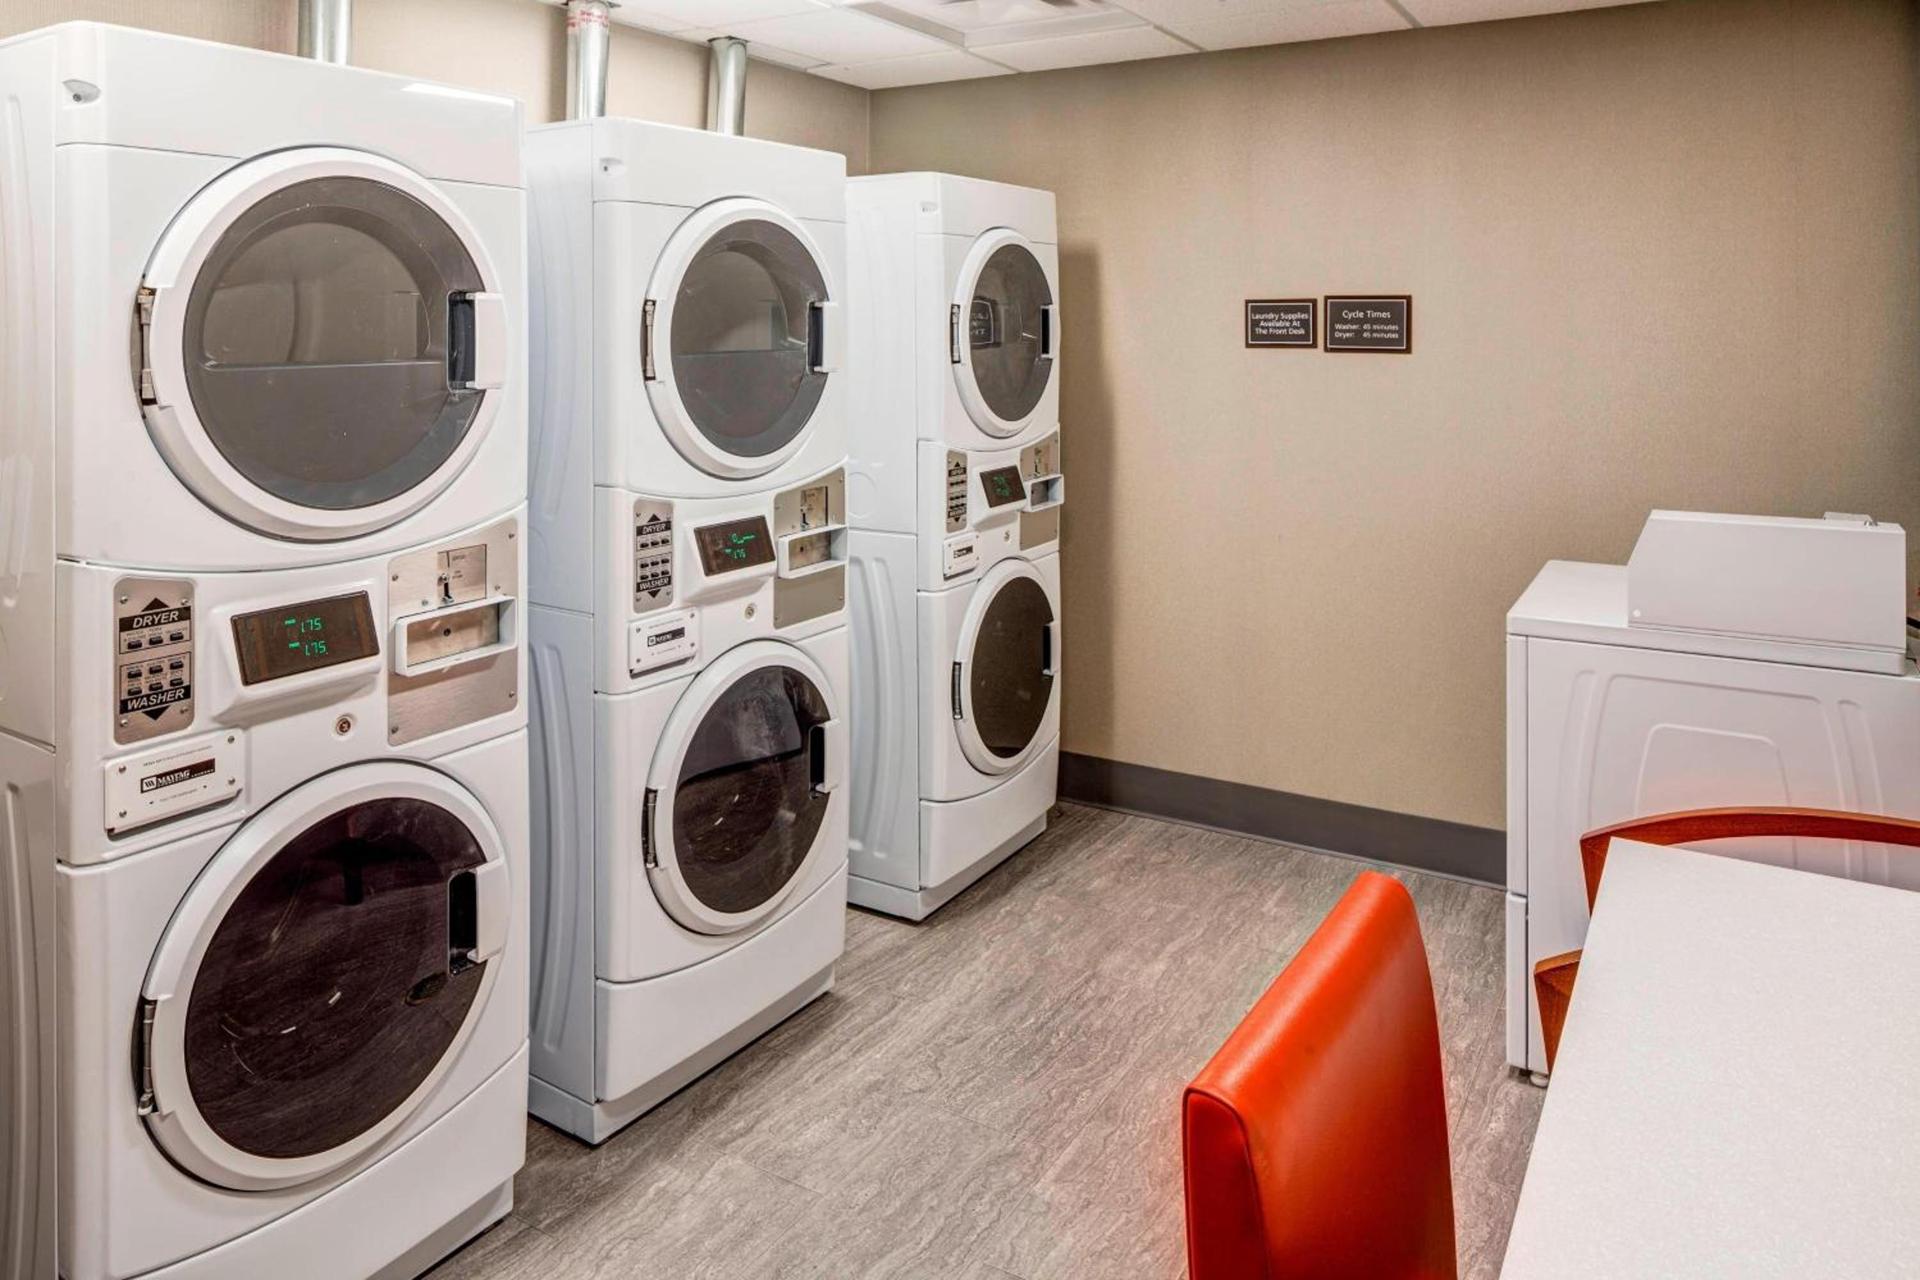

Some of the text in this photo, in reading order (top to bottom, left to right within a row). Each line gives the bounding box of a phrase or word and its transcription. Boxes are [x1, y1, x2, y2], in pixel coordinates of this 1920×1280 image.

[1251, 312, 1309, 321] Laundry Supplies
[1342, 310, 1391, 320] Cycle Times
[1255, 327, 1305, 335] The Front Desk
[132, 610, 179, 629] DRYER
[127, 688, 185, 710] WASHER
[157, 769, 191, 786] MAYTAG
